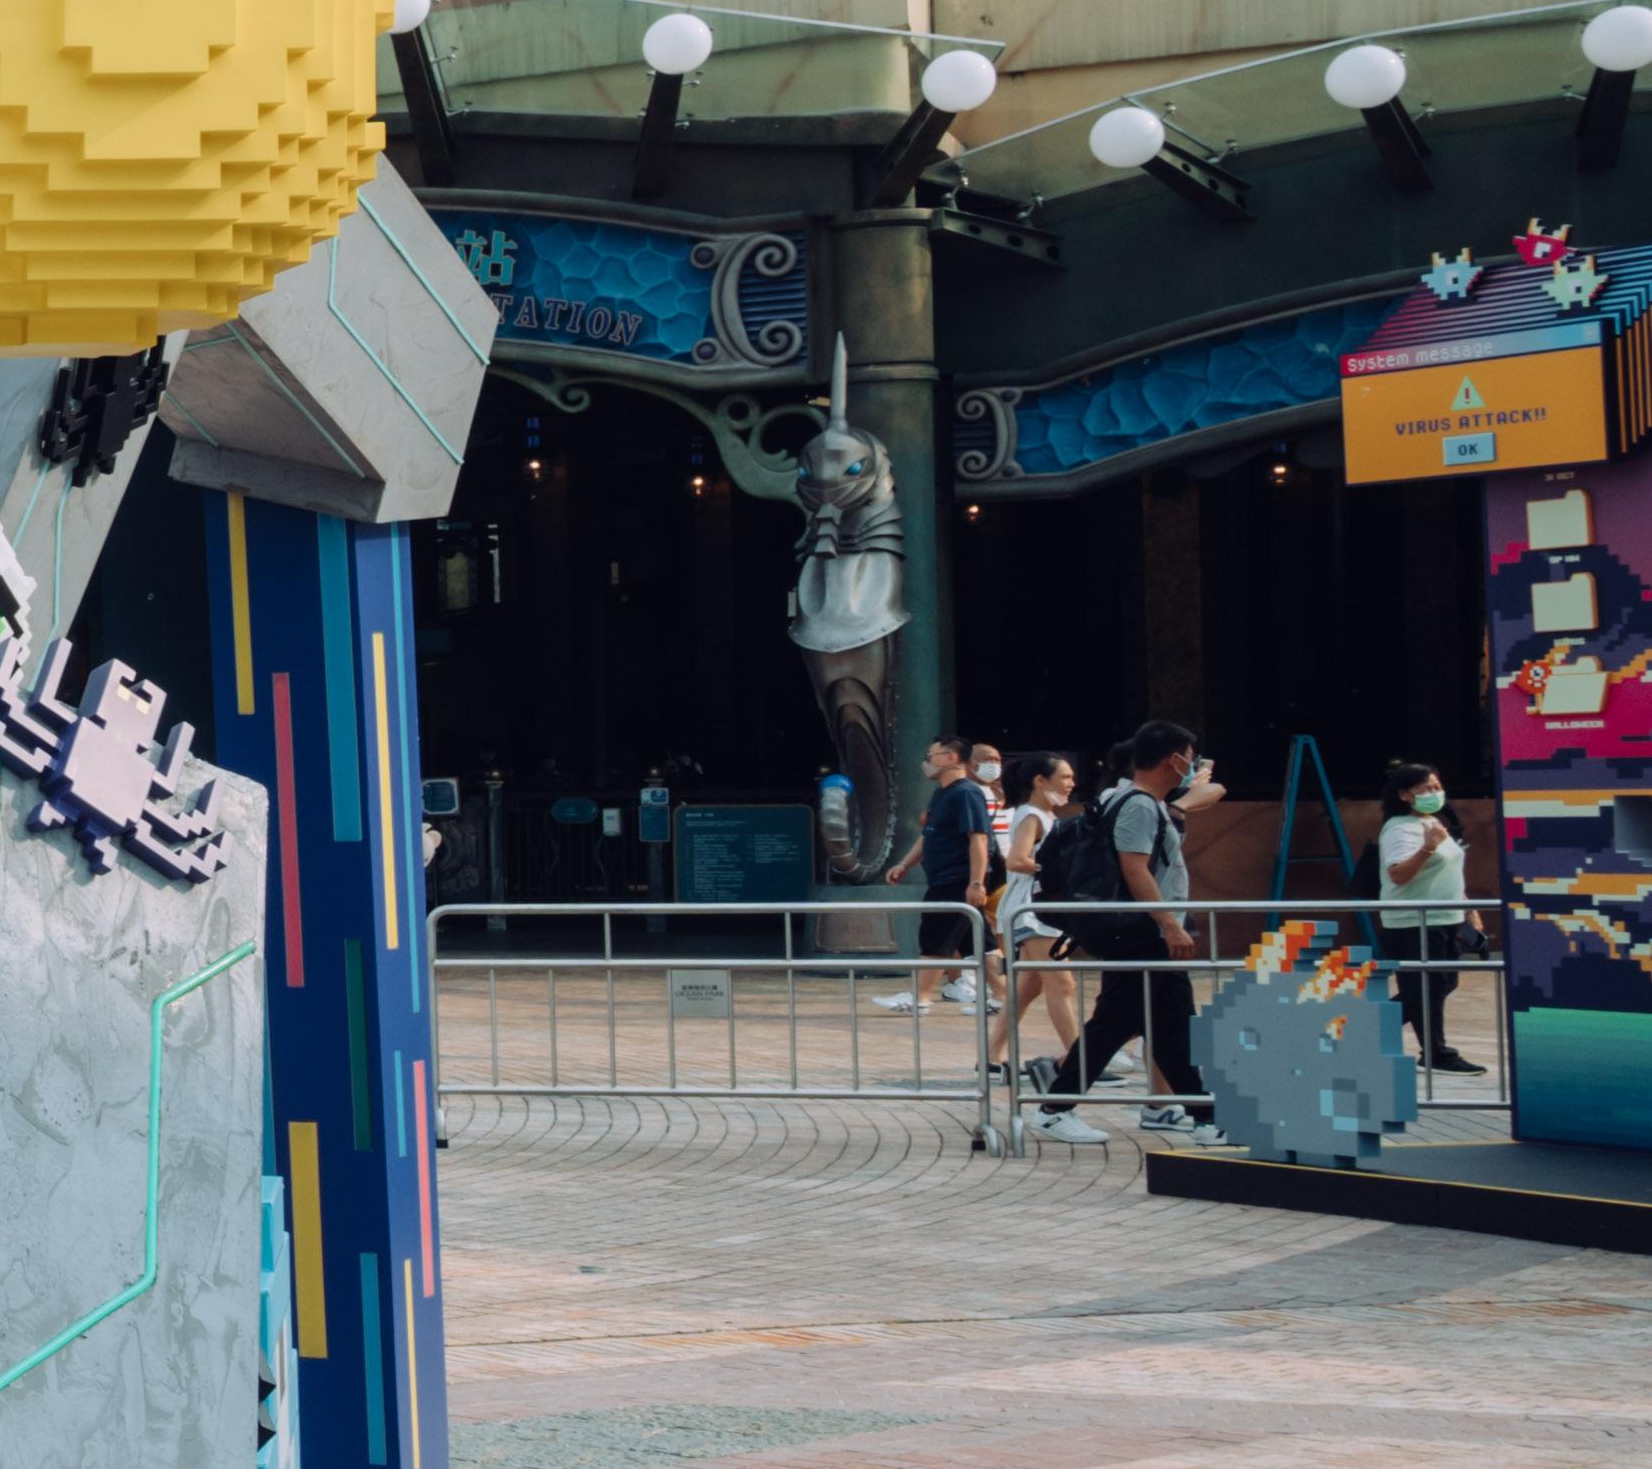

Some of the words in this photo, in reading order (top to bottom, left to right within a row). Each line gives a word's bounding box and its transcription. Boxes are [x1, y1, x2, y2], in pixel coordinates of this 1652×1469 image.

[455, 229, 518, 287] 站
[490, 292, 643, 347] TATION
[1346, 351, 1410, 373] System
[1415, 342, 1493, 364] message
[1395, 417, 1451, 436] VIRUS
[1458, 407, 1547, 430] ATTACK!!
[1457, 443, 1479, 456] OK
